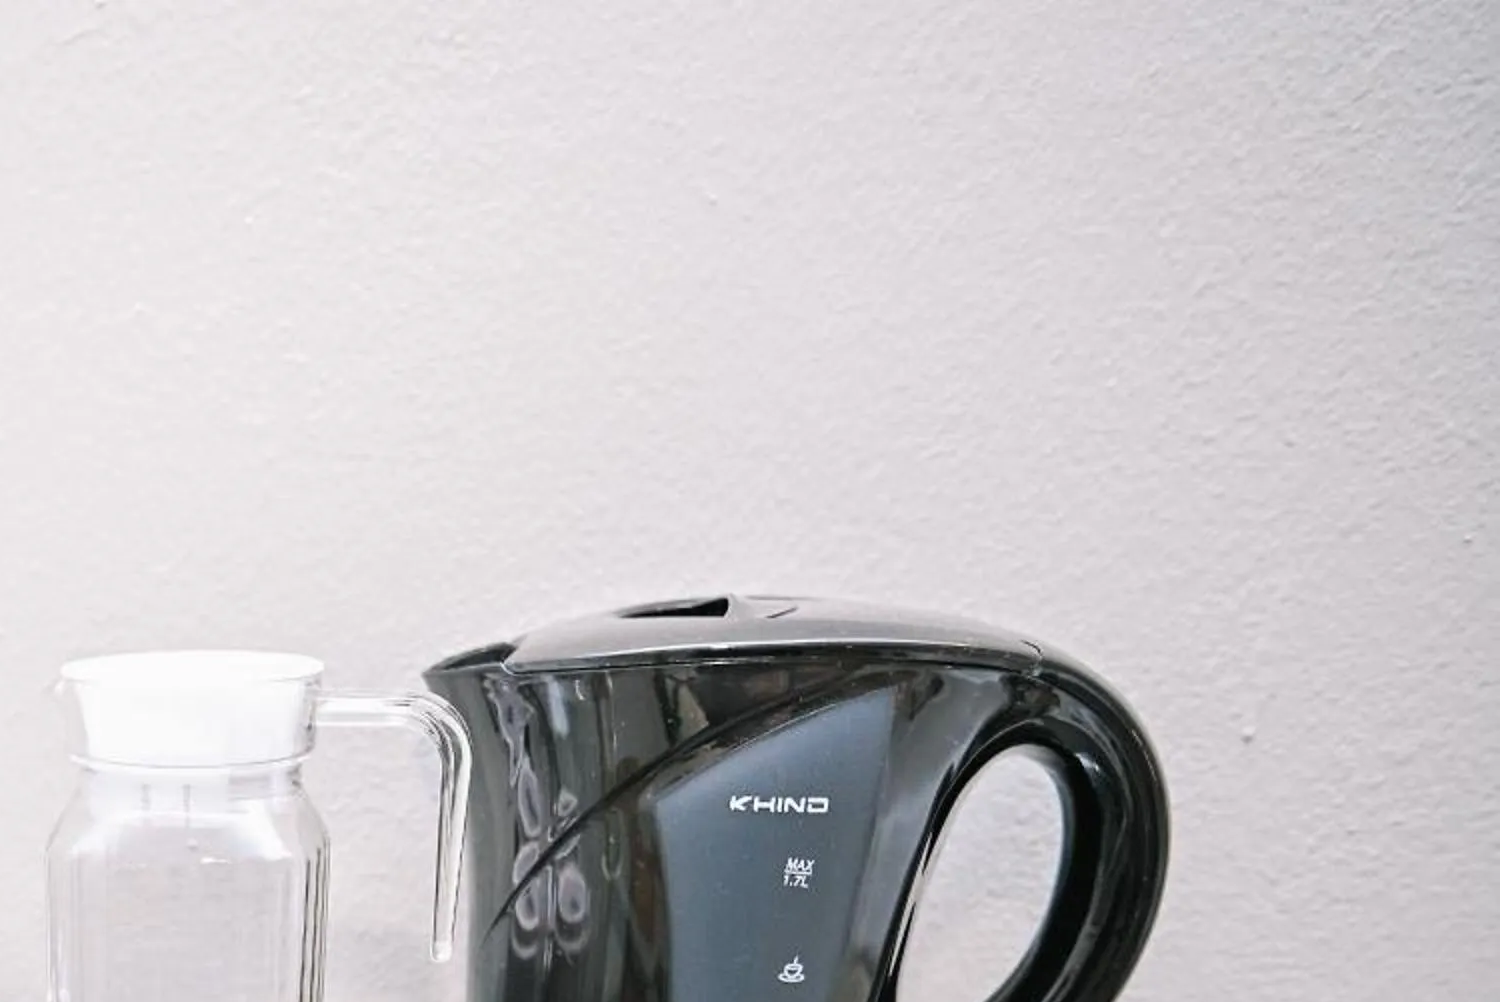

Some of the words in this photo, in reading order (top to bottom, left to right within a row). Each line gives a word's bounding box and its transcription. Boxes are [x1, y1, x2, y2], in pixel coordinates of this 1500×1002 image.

[729, 795, 830, 813] KHIND
[784, 857, 815, 872] MAX
[783, 875, 809, 889] 1.7L
